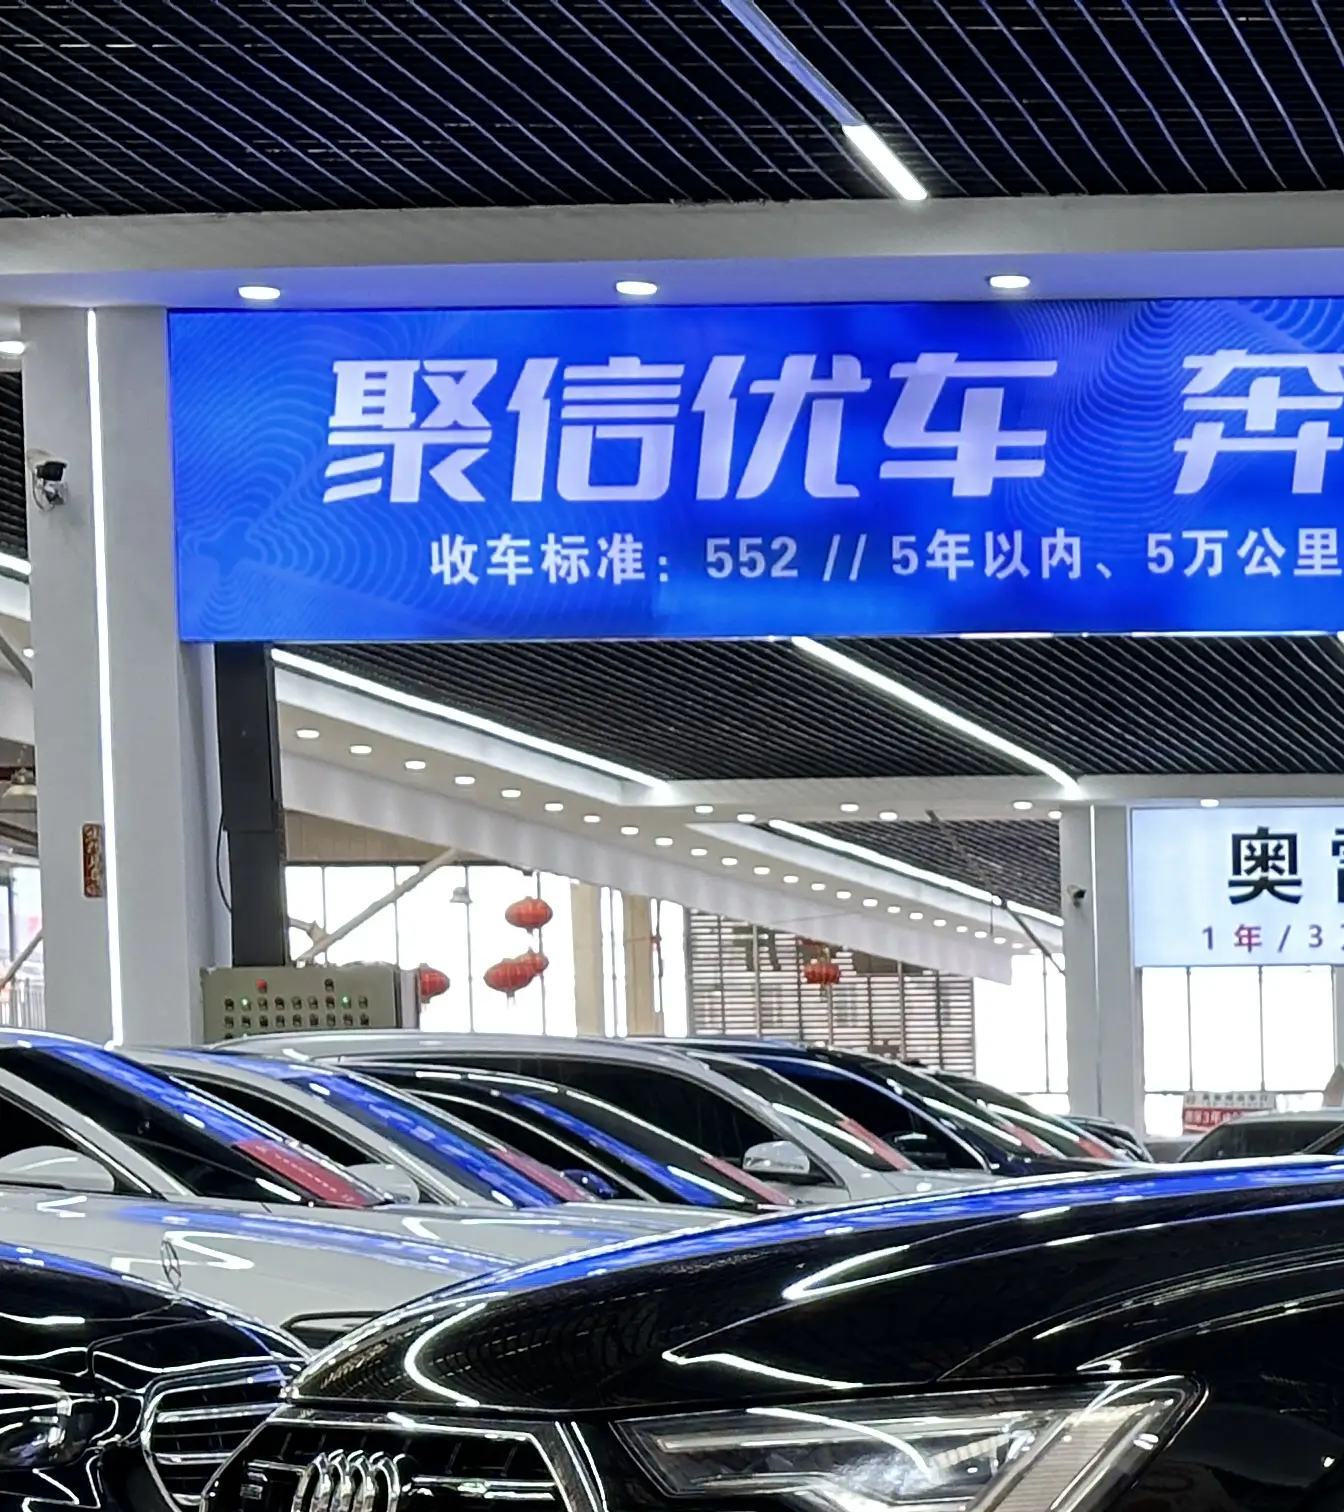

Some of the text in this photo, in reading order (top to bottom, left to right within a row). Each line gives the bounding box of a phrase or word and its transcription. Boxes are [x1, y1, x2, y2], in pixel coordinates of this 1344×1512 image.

[322, 353, 1059, 503] 聚信优车
[430, 532, 670, 585] 收车标准：
[705, 536, 799, 579] 552
